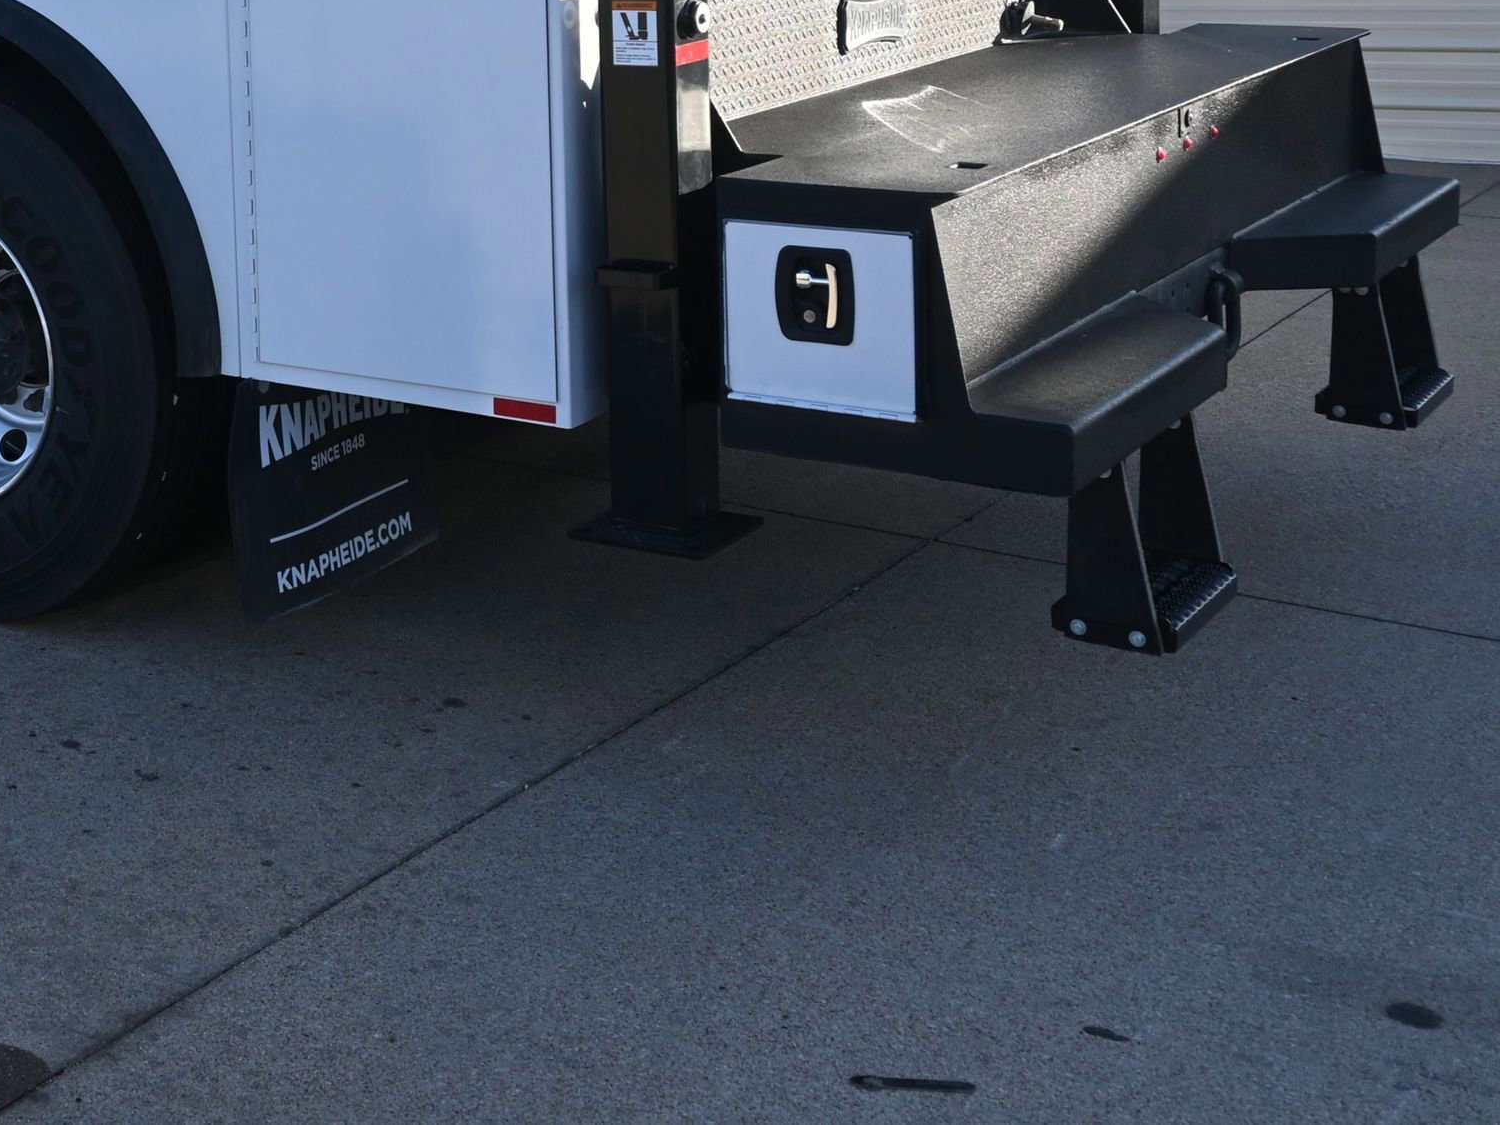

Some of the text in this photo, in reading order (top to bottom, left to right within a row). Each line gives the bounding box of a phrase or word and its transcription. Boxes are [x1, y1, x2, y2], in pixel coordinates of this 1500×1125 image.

[259, 392, 404, 469] KNAPHEI
[311, 433, 365, 470] SINCE 1848
[277, 512, 412, 593] KNAPHEIDE.COM
